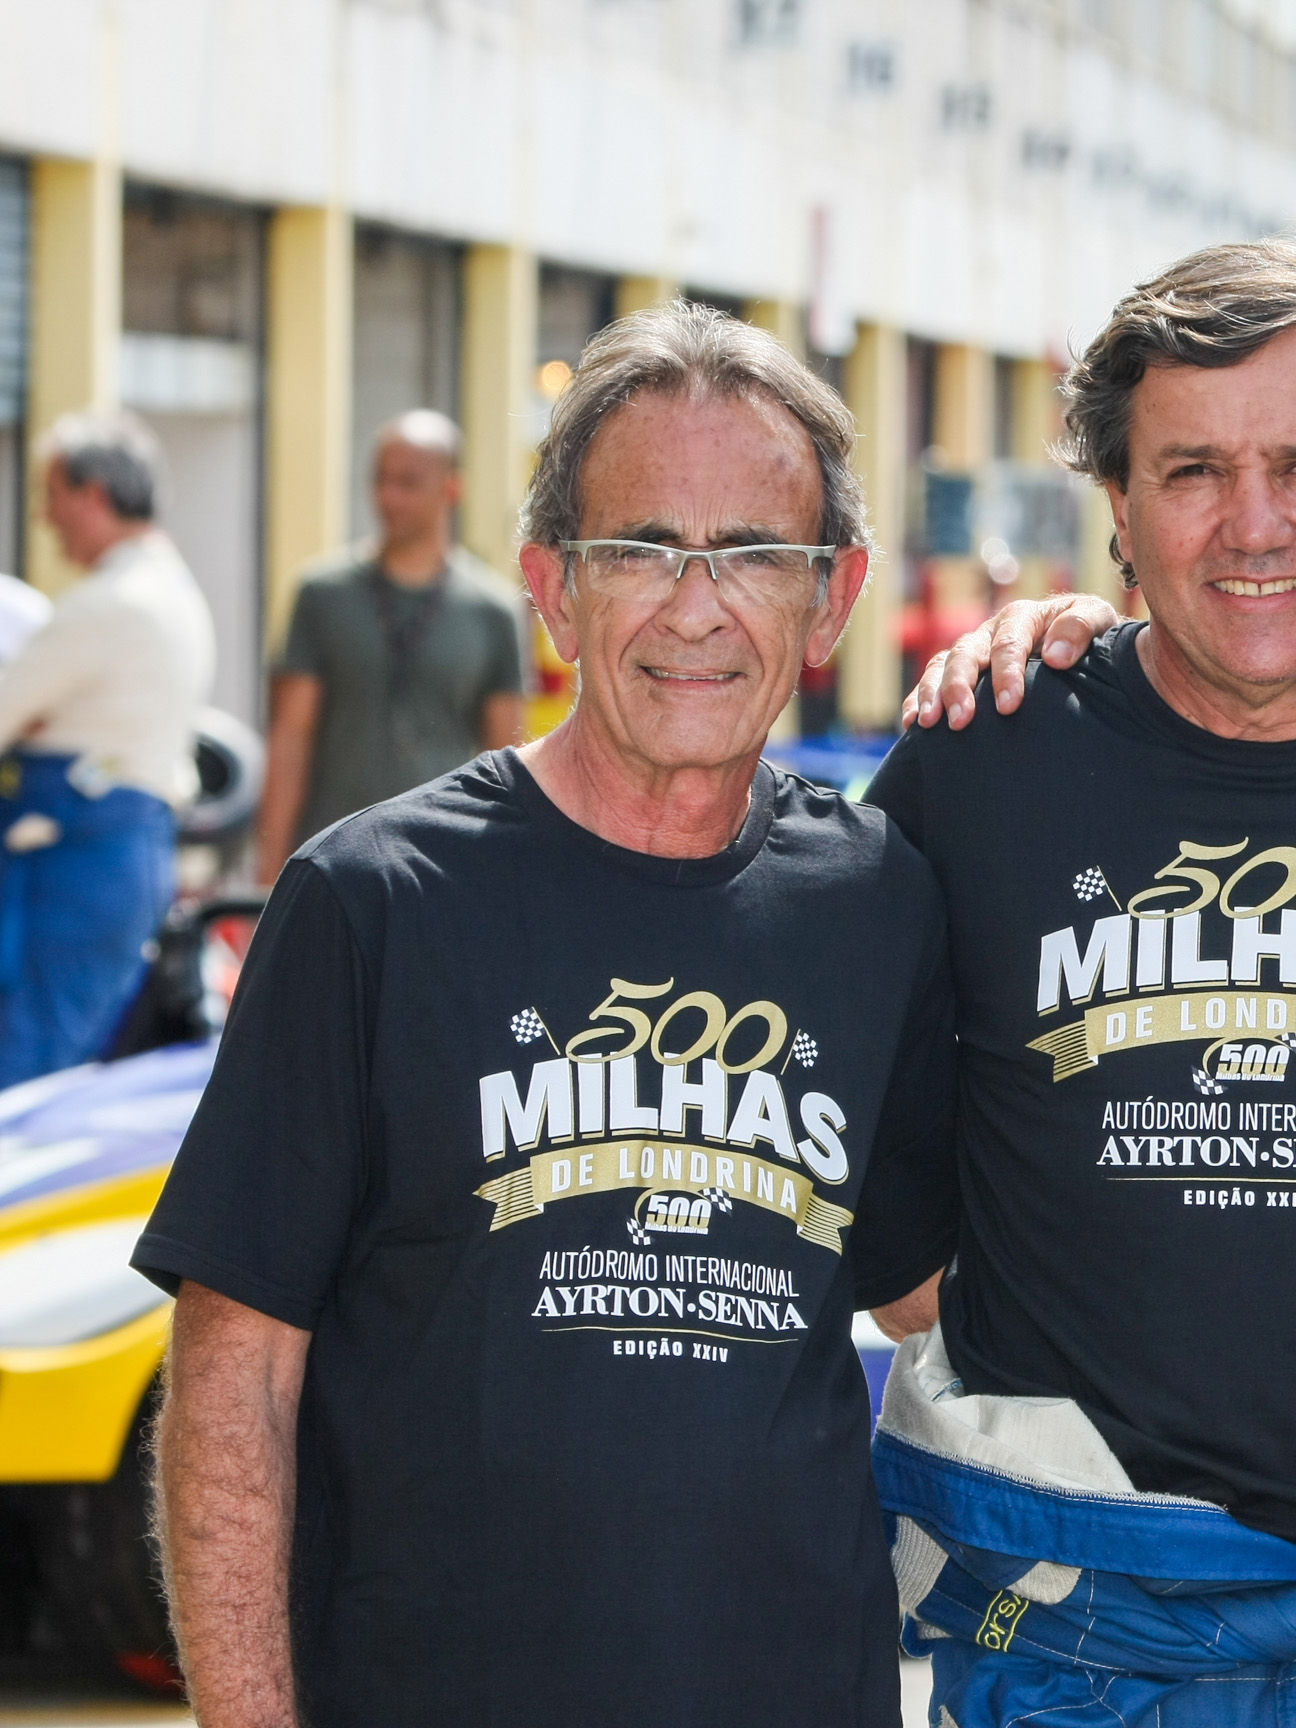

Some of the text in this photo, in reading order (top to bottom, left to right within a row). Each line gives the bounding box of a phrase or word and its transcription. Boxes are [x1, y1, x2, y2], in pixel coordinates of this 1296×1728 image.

[566, 977, 787, 1074] 500
[1105, 1005, 1153, 1045] DE
[1217, 1044, 1290, 1075] 500
[479, 1051, 849, 1185] MILHAS
[1102, 1096, 1231, 1130] AUTÓDROMO
[551, 1148, 797, 1214] DE LONDRINA
[1183, 1187, 1255, 1209] EDIÇÃO
[646, 1194, 712, 1228] 500
[539, 1246, 799, 1297] AUTÓDROMO INTERNACIONAL
[613, 1337, 728, 1363] EDIÇÃO XXIV
